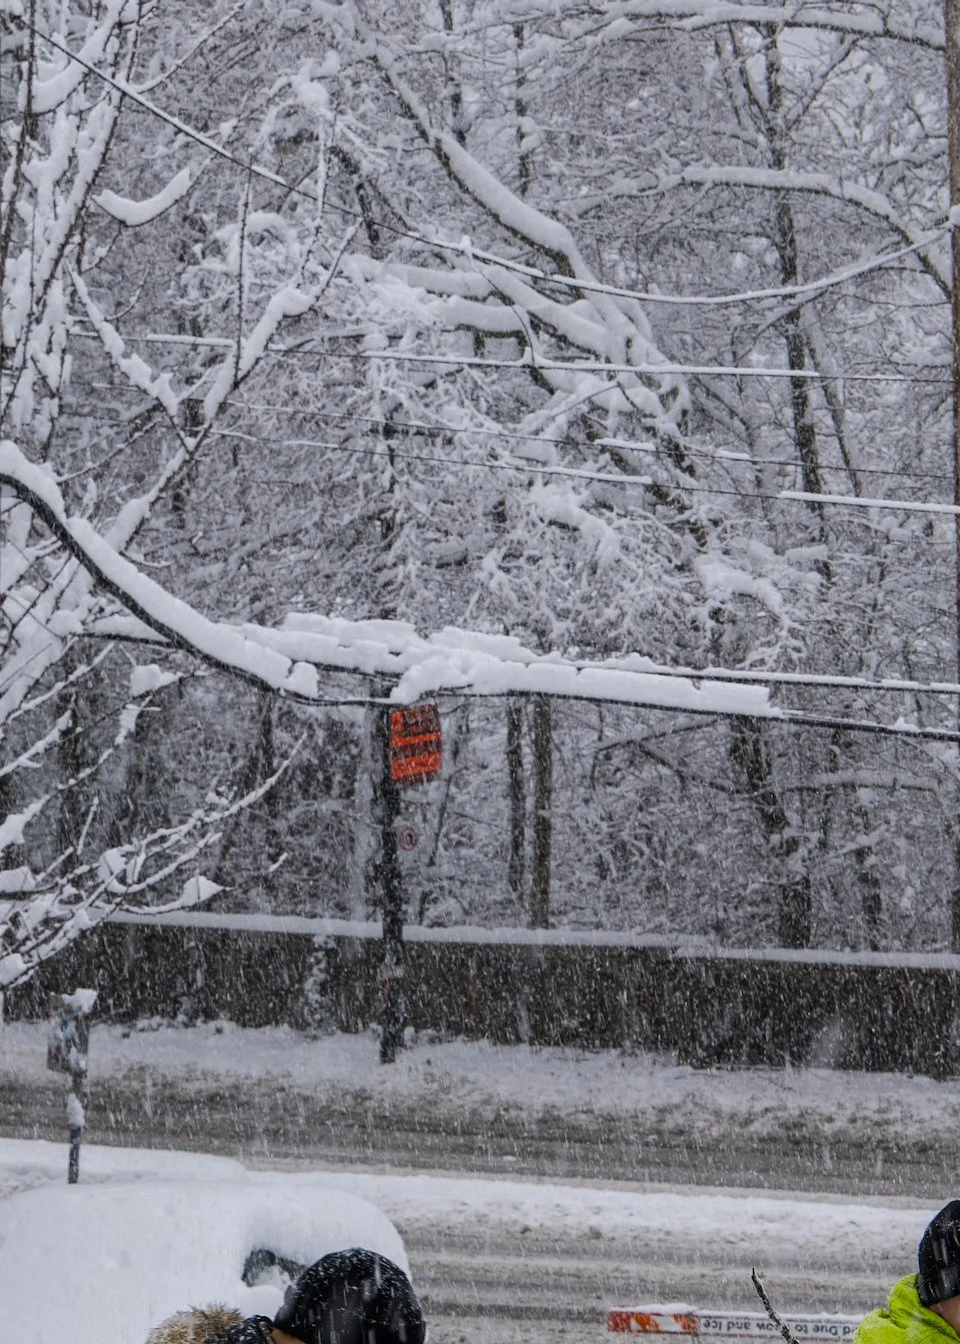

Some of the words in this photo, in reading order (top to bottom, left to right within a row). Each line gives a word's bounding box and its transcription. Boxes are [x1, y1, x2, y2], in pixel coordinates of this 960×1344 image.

[703, 1320, 722, 1330] Ice
[727, 1320, 750, 1330] and
[794, 1324, 808, 1334] to
[812, 1325, 838, 1336] Due
